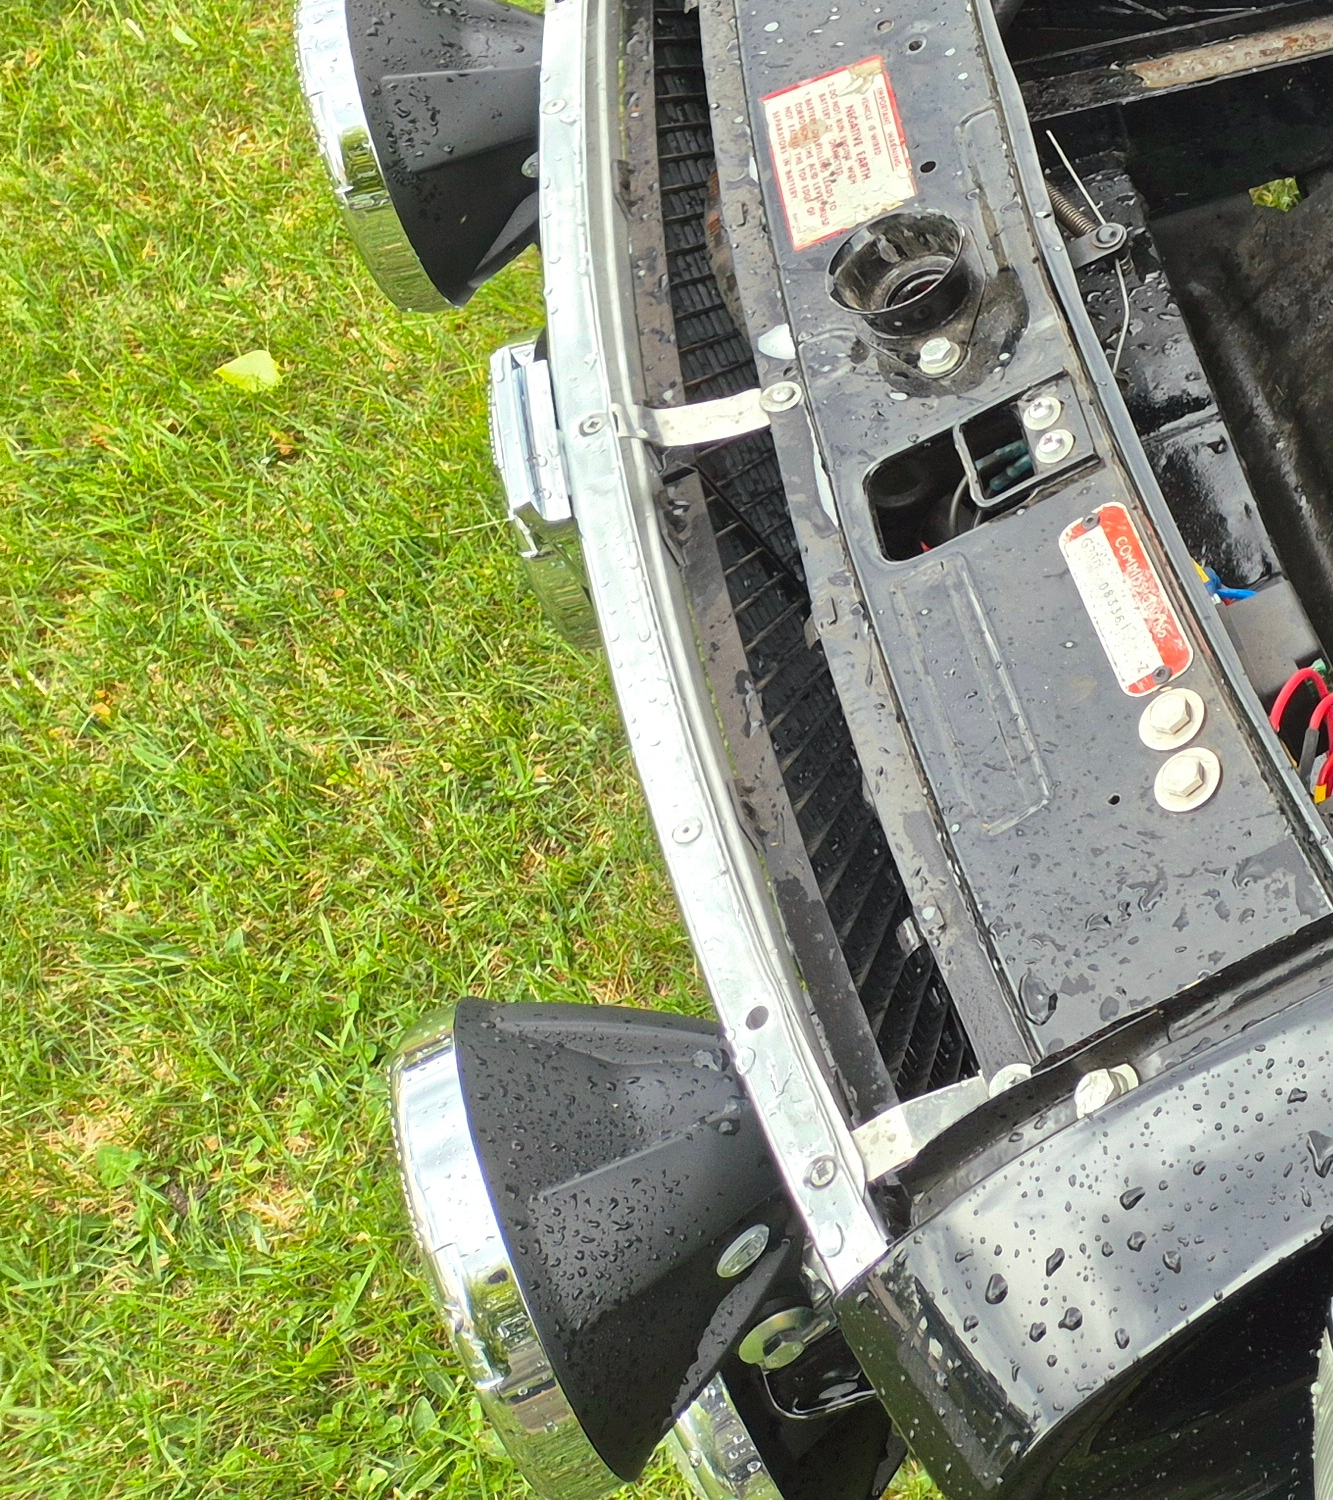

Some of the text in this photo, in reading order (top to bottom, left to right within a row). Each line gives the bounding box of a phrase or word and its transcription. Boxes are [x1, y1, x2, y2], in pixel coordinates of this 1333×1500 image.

[828, 88, 837, 100] DO
[783, 105, 793, 120] NOT
[817, 92, 831, 121] BATTERY
[831, 100, 841, 115] NOT
[875, 86, 891, 126] IMPORTANT
[835, 117, 845, 133] RUN
[844, 104, 863, 147] NEGATIVE
[860, 95, 881, 156] VEHICLE IS WIRED
[771, 110, 788, 154] SEPARATORS
[782, 157, 791, 167] IN
[839, 135, 852, 161] ENGINE
[793, 151, 803, 165] THE
[803, 146, 812, 159] THE
[803, 97, 817, 126] BATTERY
[821, 175, 834, 199] LEADS
[828, 200, 837, 212] TO
[797, 167, 807, 182] TOP
[807, 162, 818, 180] ACID
[846, 164, 857, 185] WITH
[801, 184, 812, 204] EDGE
[806, 205, 815, 217] OF
[817, 205, 829, 227] MUST
[1113, 534, 1161, 618] COMMISSION
